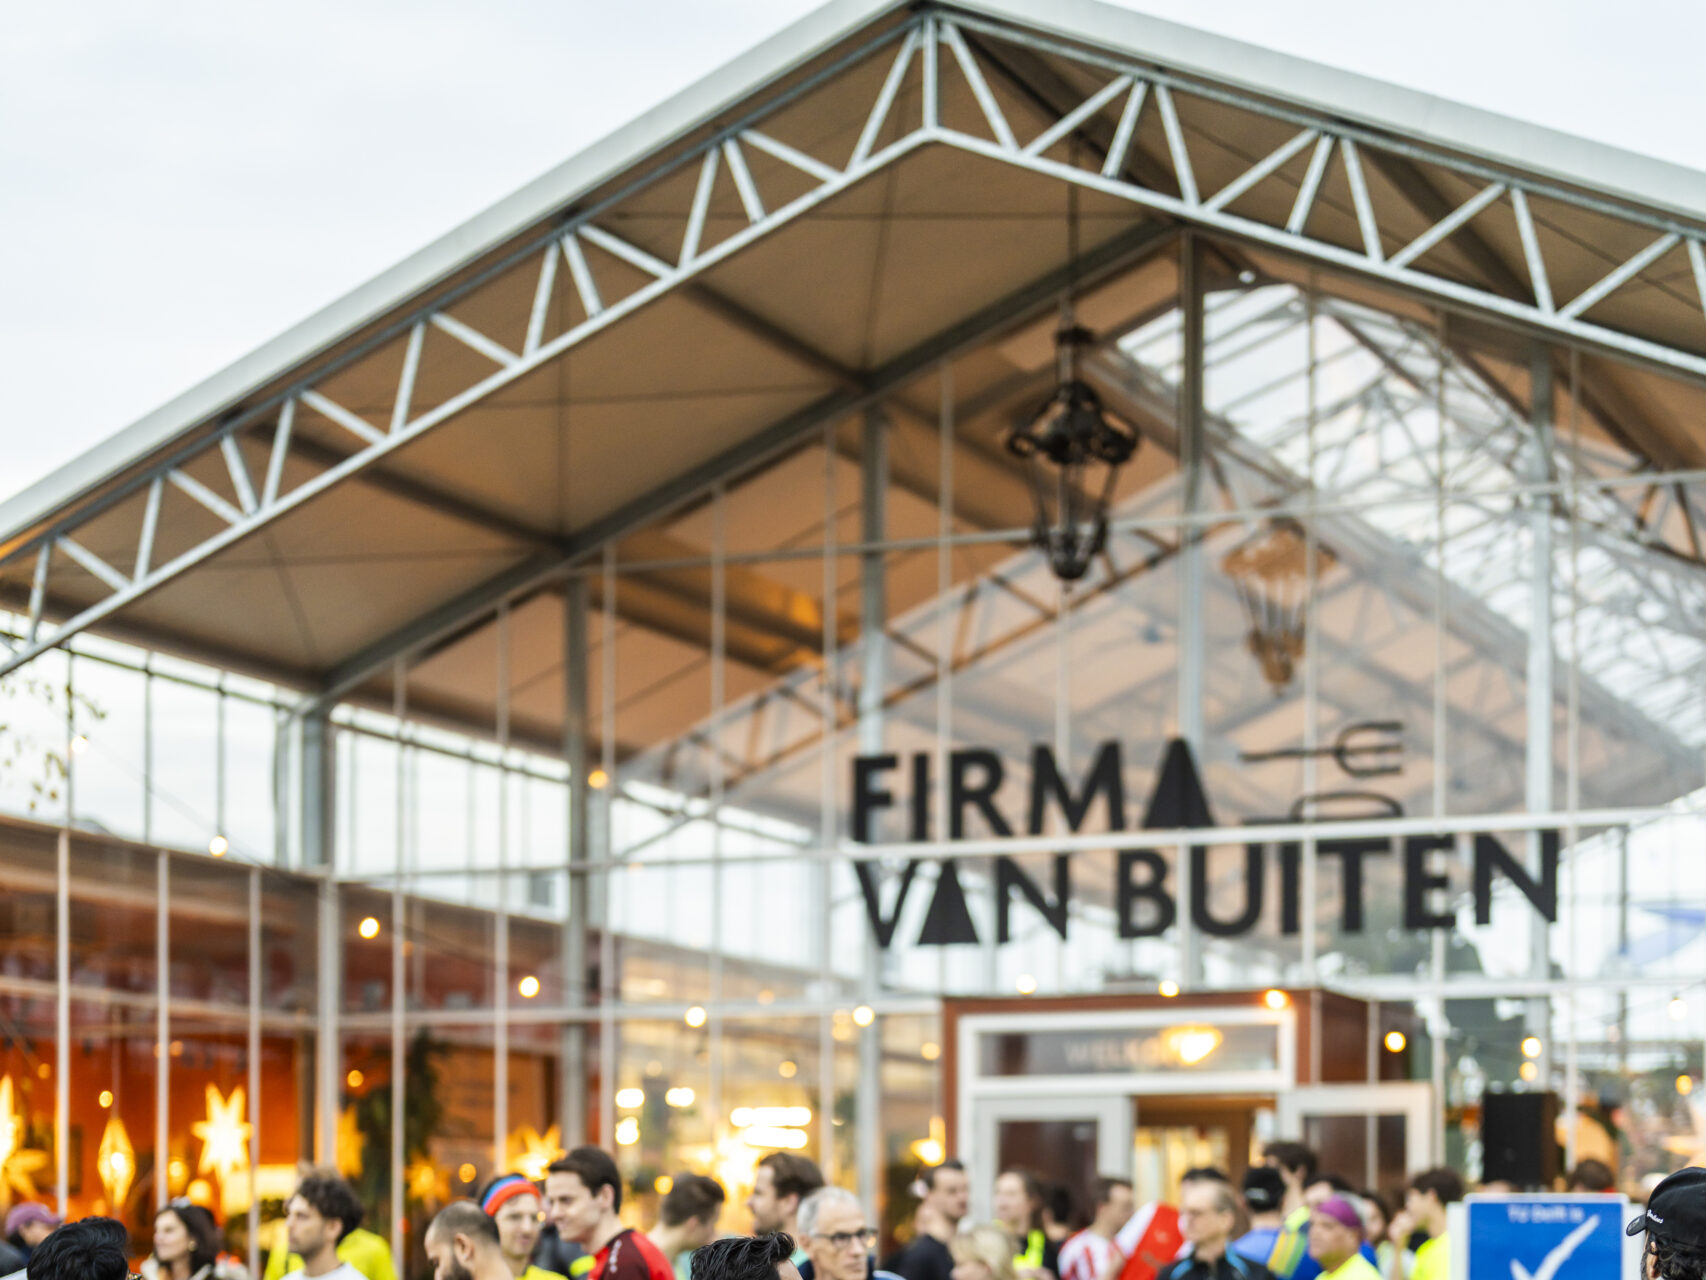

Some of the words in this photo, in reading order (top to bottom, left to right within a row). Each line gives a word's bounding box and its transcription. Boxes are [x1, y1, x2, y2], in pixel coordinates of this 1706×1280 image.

[852, 737, 1215, 842] FIRMA
[854, 853, 1070, 948] VAN
[1117, 829, 1559, 939] BUITEN
